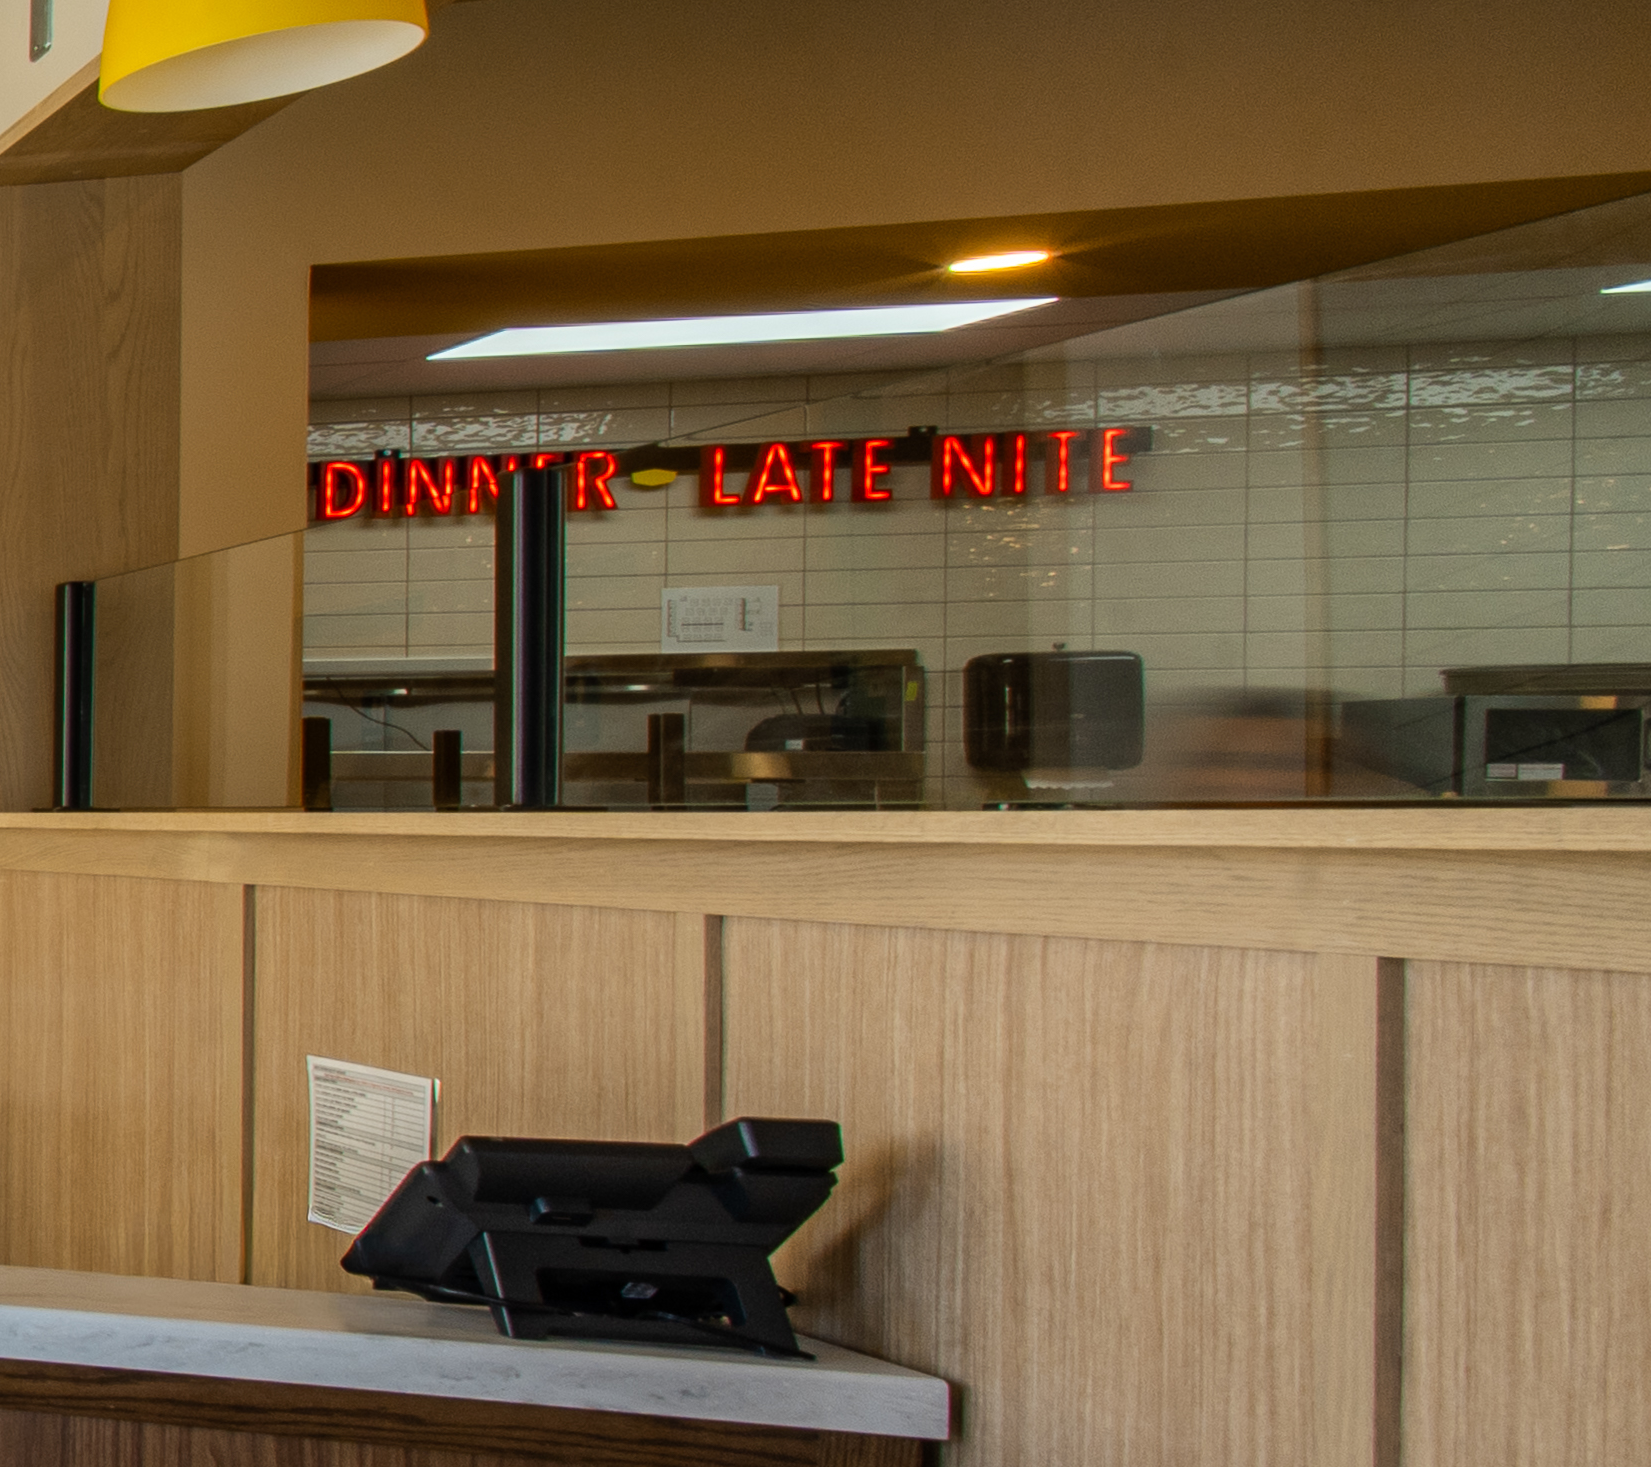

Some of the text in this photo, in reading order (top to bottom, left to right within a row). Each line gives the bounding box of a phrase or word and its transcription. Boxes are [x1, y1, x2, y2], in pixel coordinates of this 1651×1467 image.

[320, 428, 1132, 519] DINNR LATE NITE
